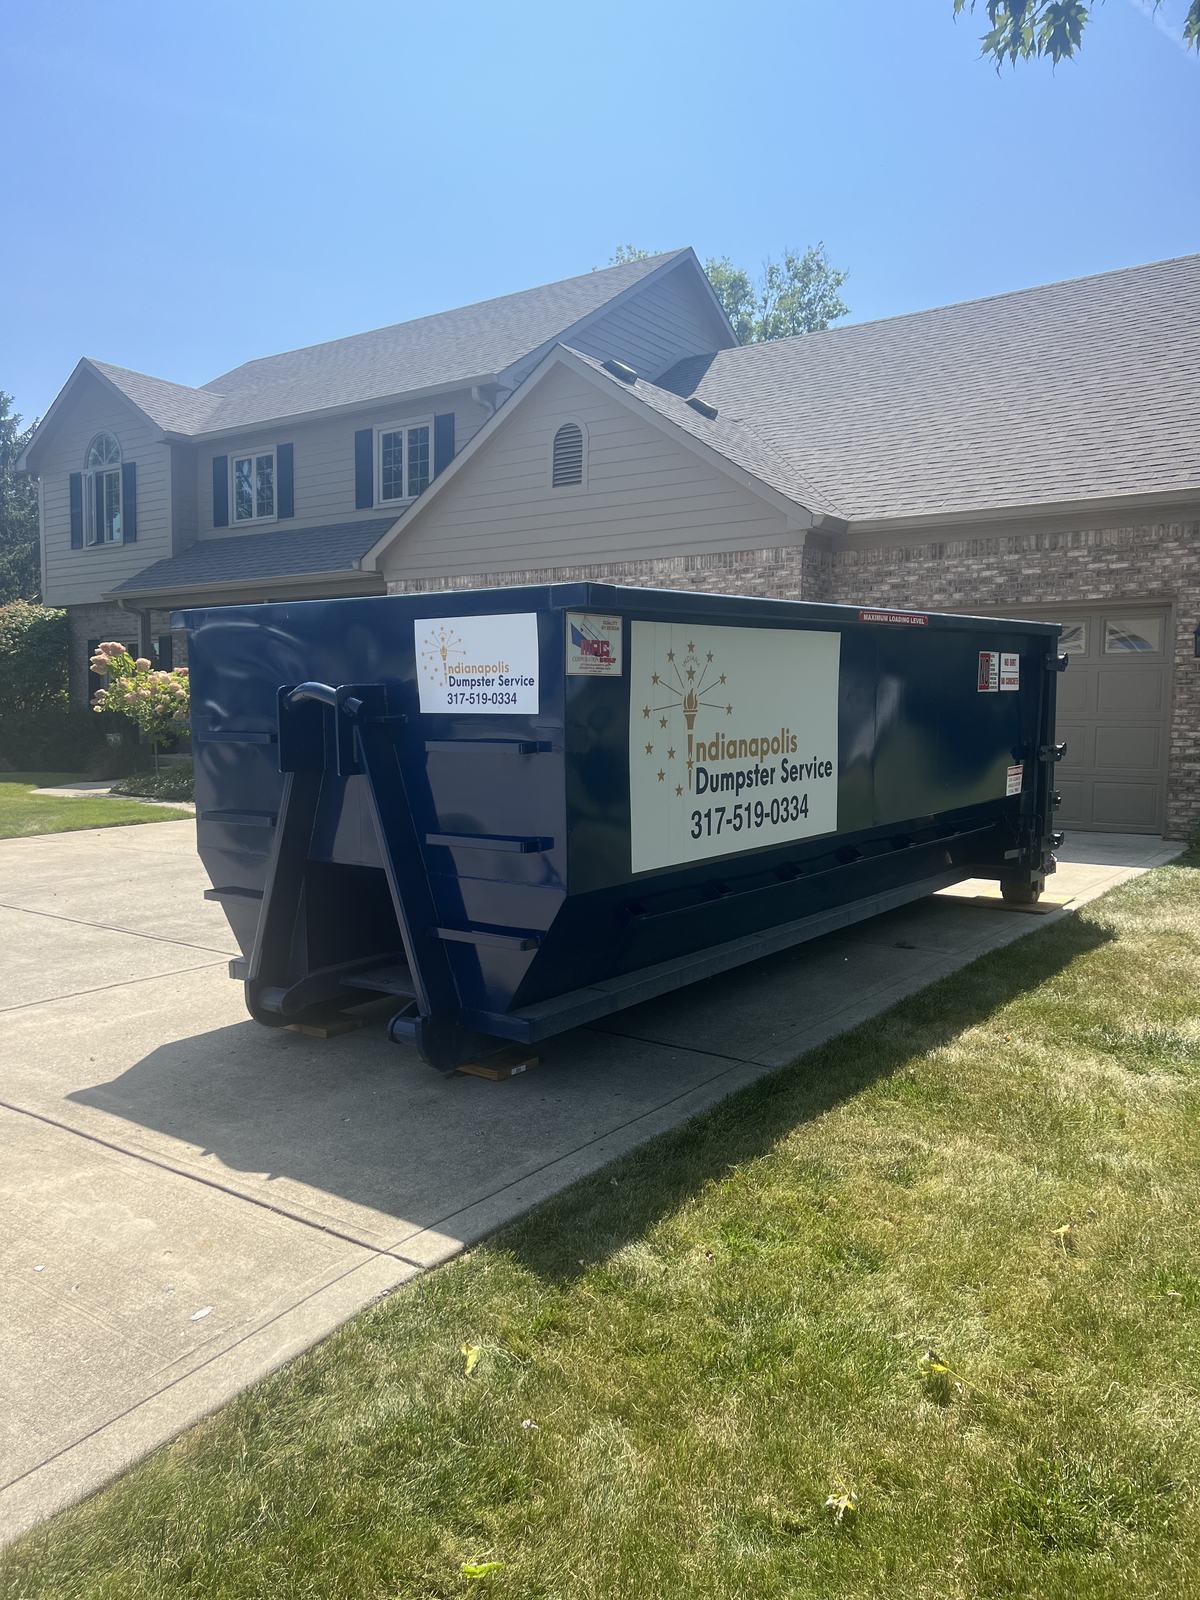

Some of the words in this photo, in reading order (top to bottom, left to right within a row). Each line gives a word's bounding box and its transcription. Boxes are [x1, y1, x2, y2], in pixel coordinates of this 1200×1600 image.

[863, 613, 888, 622] MAXIMUM
[910, 617, 925, 625] LEVEL
[444, 661, 510, 677] Indianapolis
[449, 676, 495, 690] Dumpster
[498, 674, 535, 687] Service
[447, 692, 518, 705] 317-519-0334
[687, 727, 798, 764] Indianapolis
[695, 763, 776, 797] Dumpster
[780, 755, 833, 784] Service
[690, 794, 809, 840] 317-519-0334
